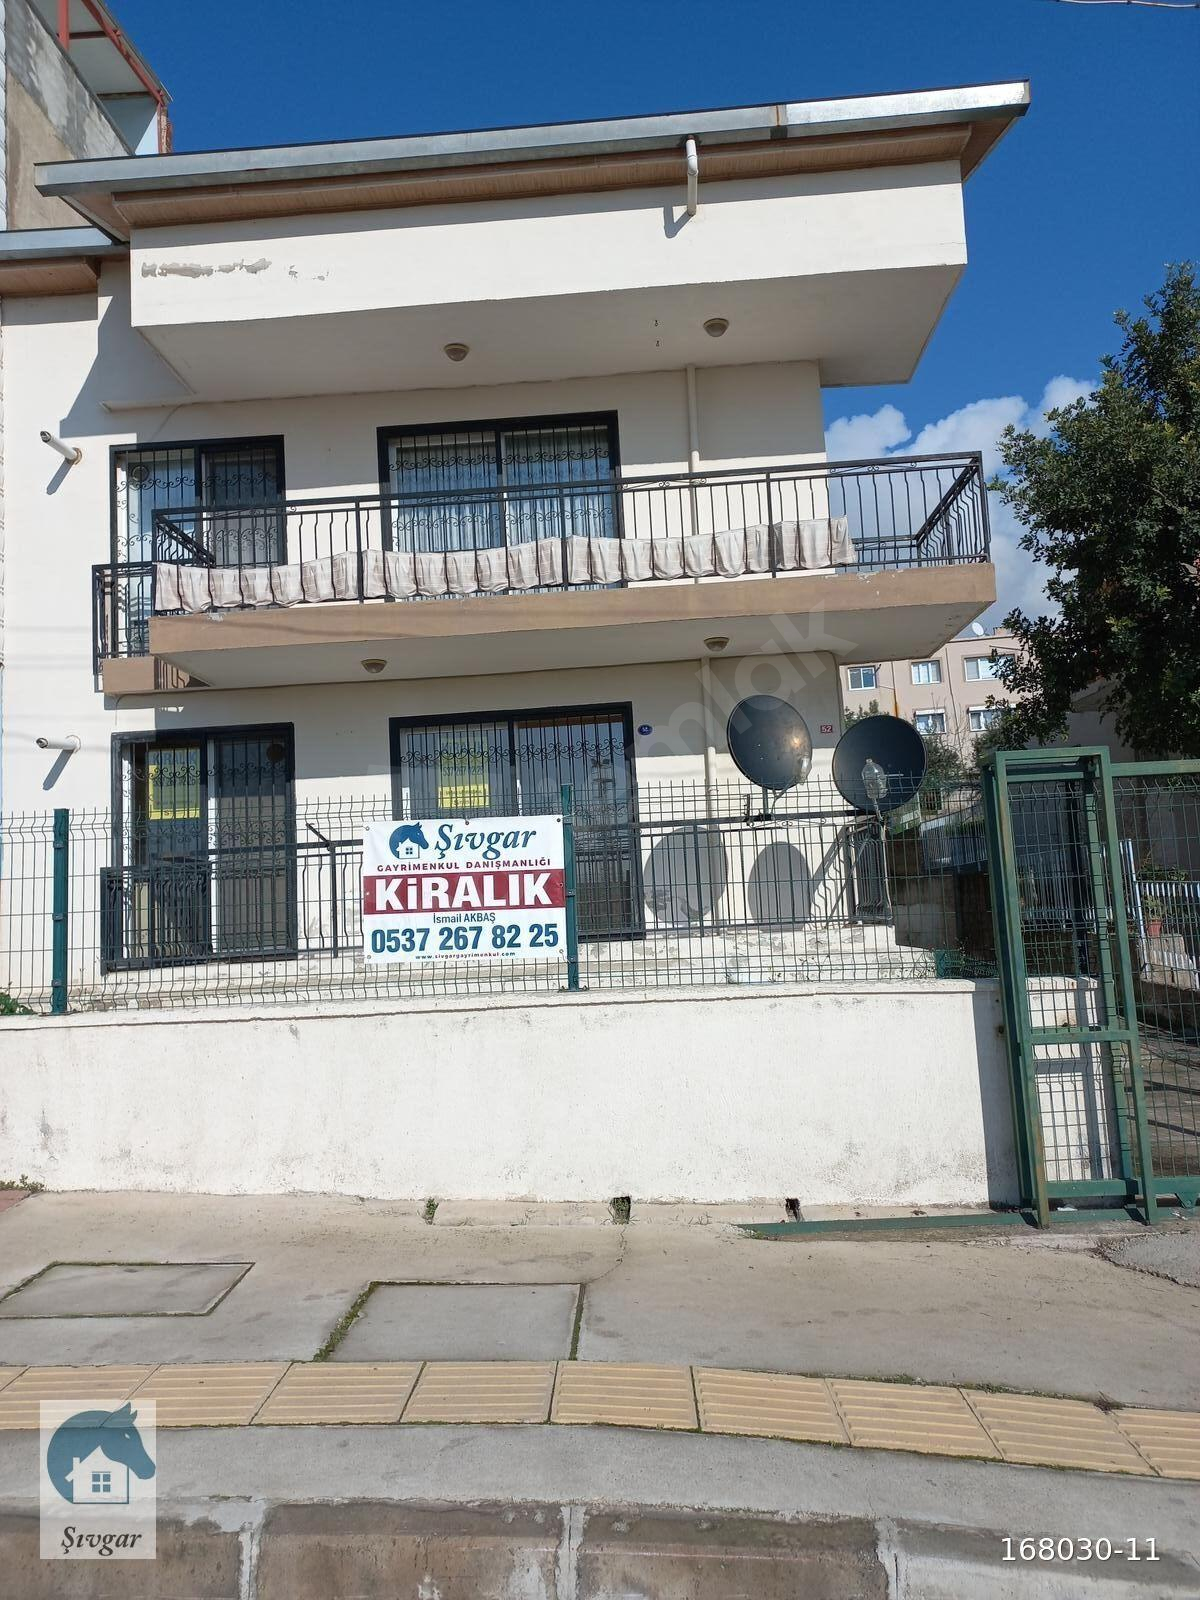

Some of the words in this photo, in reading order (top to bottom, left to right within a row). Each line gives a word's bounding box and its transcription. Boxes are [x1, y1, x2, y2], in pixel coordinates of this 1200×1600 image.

[434, 823, 537, 860] Şıvgar
[377, 861, 460, 872] GAYRİMENKUL
[466, 857, 551, 870] DANIŞMANLIĞI
[433, 913, 462, 924] İsmail
[464, 912, 496, 924] AKBAŞ
[371, 928, 430, 953] 0537
[439, 926, 483, 951] 267
[492, 924, 521, 949] 82
[529, 923, 559, 948] 25
[415, 951, 516, 960] www.sivgargayrimenkul.com
